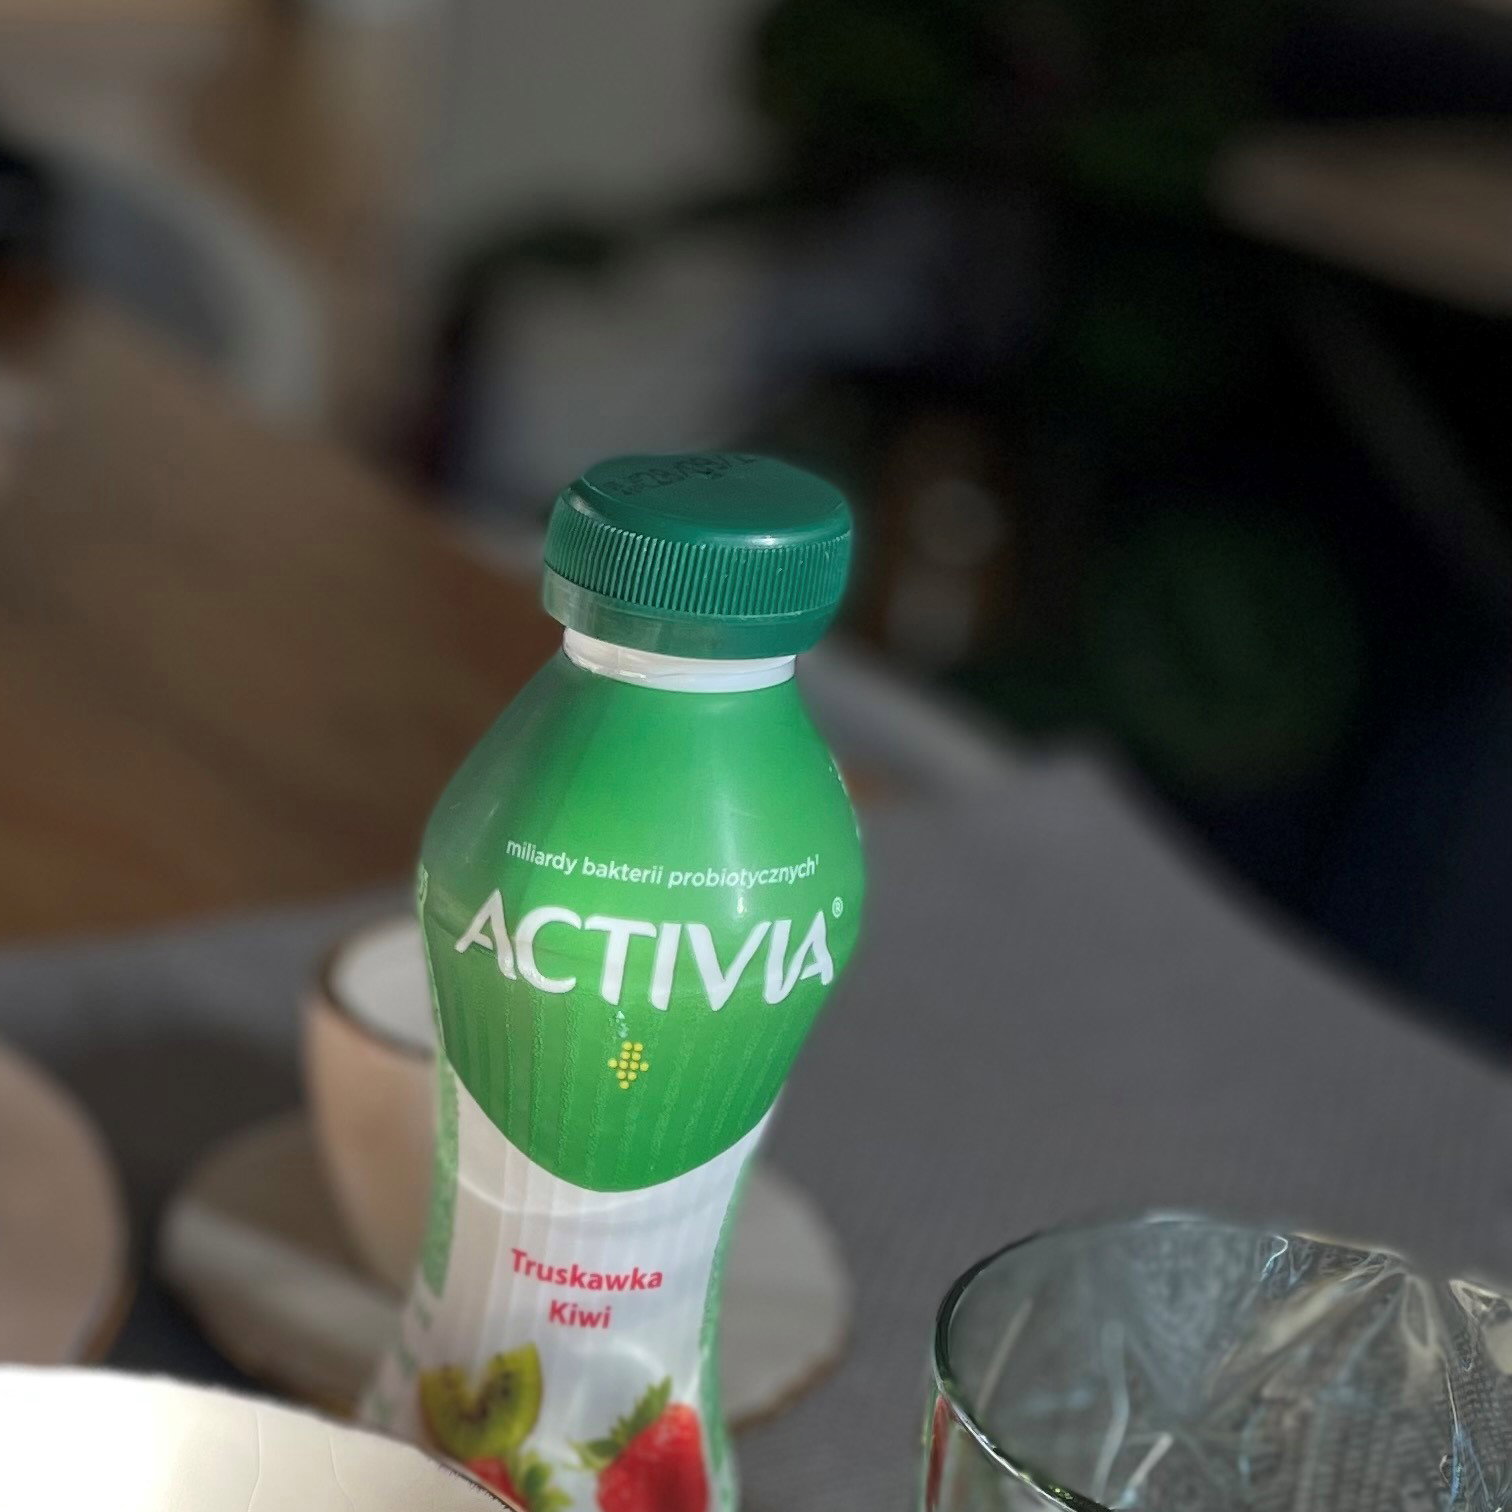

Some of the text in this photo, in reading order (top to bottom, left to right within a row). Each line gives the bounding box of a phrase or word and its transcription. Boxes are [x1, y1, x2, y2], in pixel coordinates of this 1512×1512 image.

[506, 839, 578, 875] miliardy
[581, 856, 664, 885] bakterii
[454, 888, 834, 1012] ACTIVIA
[512, 1248, 663, 1291] Truskawka
[549, 1300, 611, 1329] Kiwi
